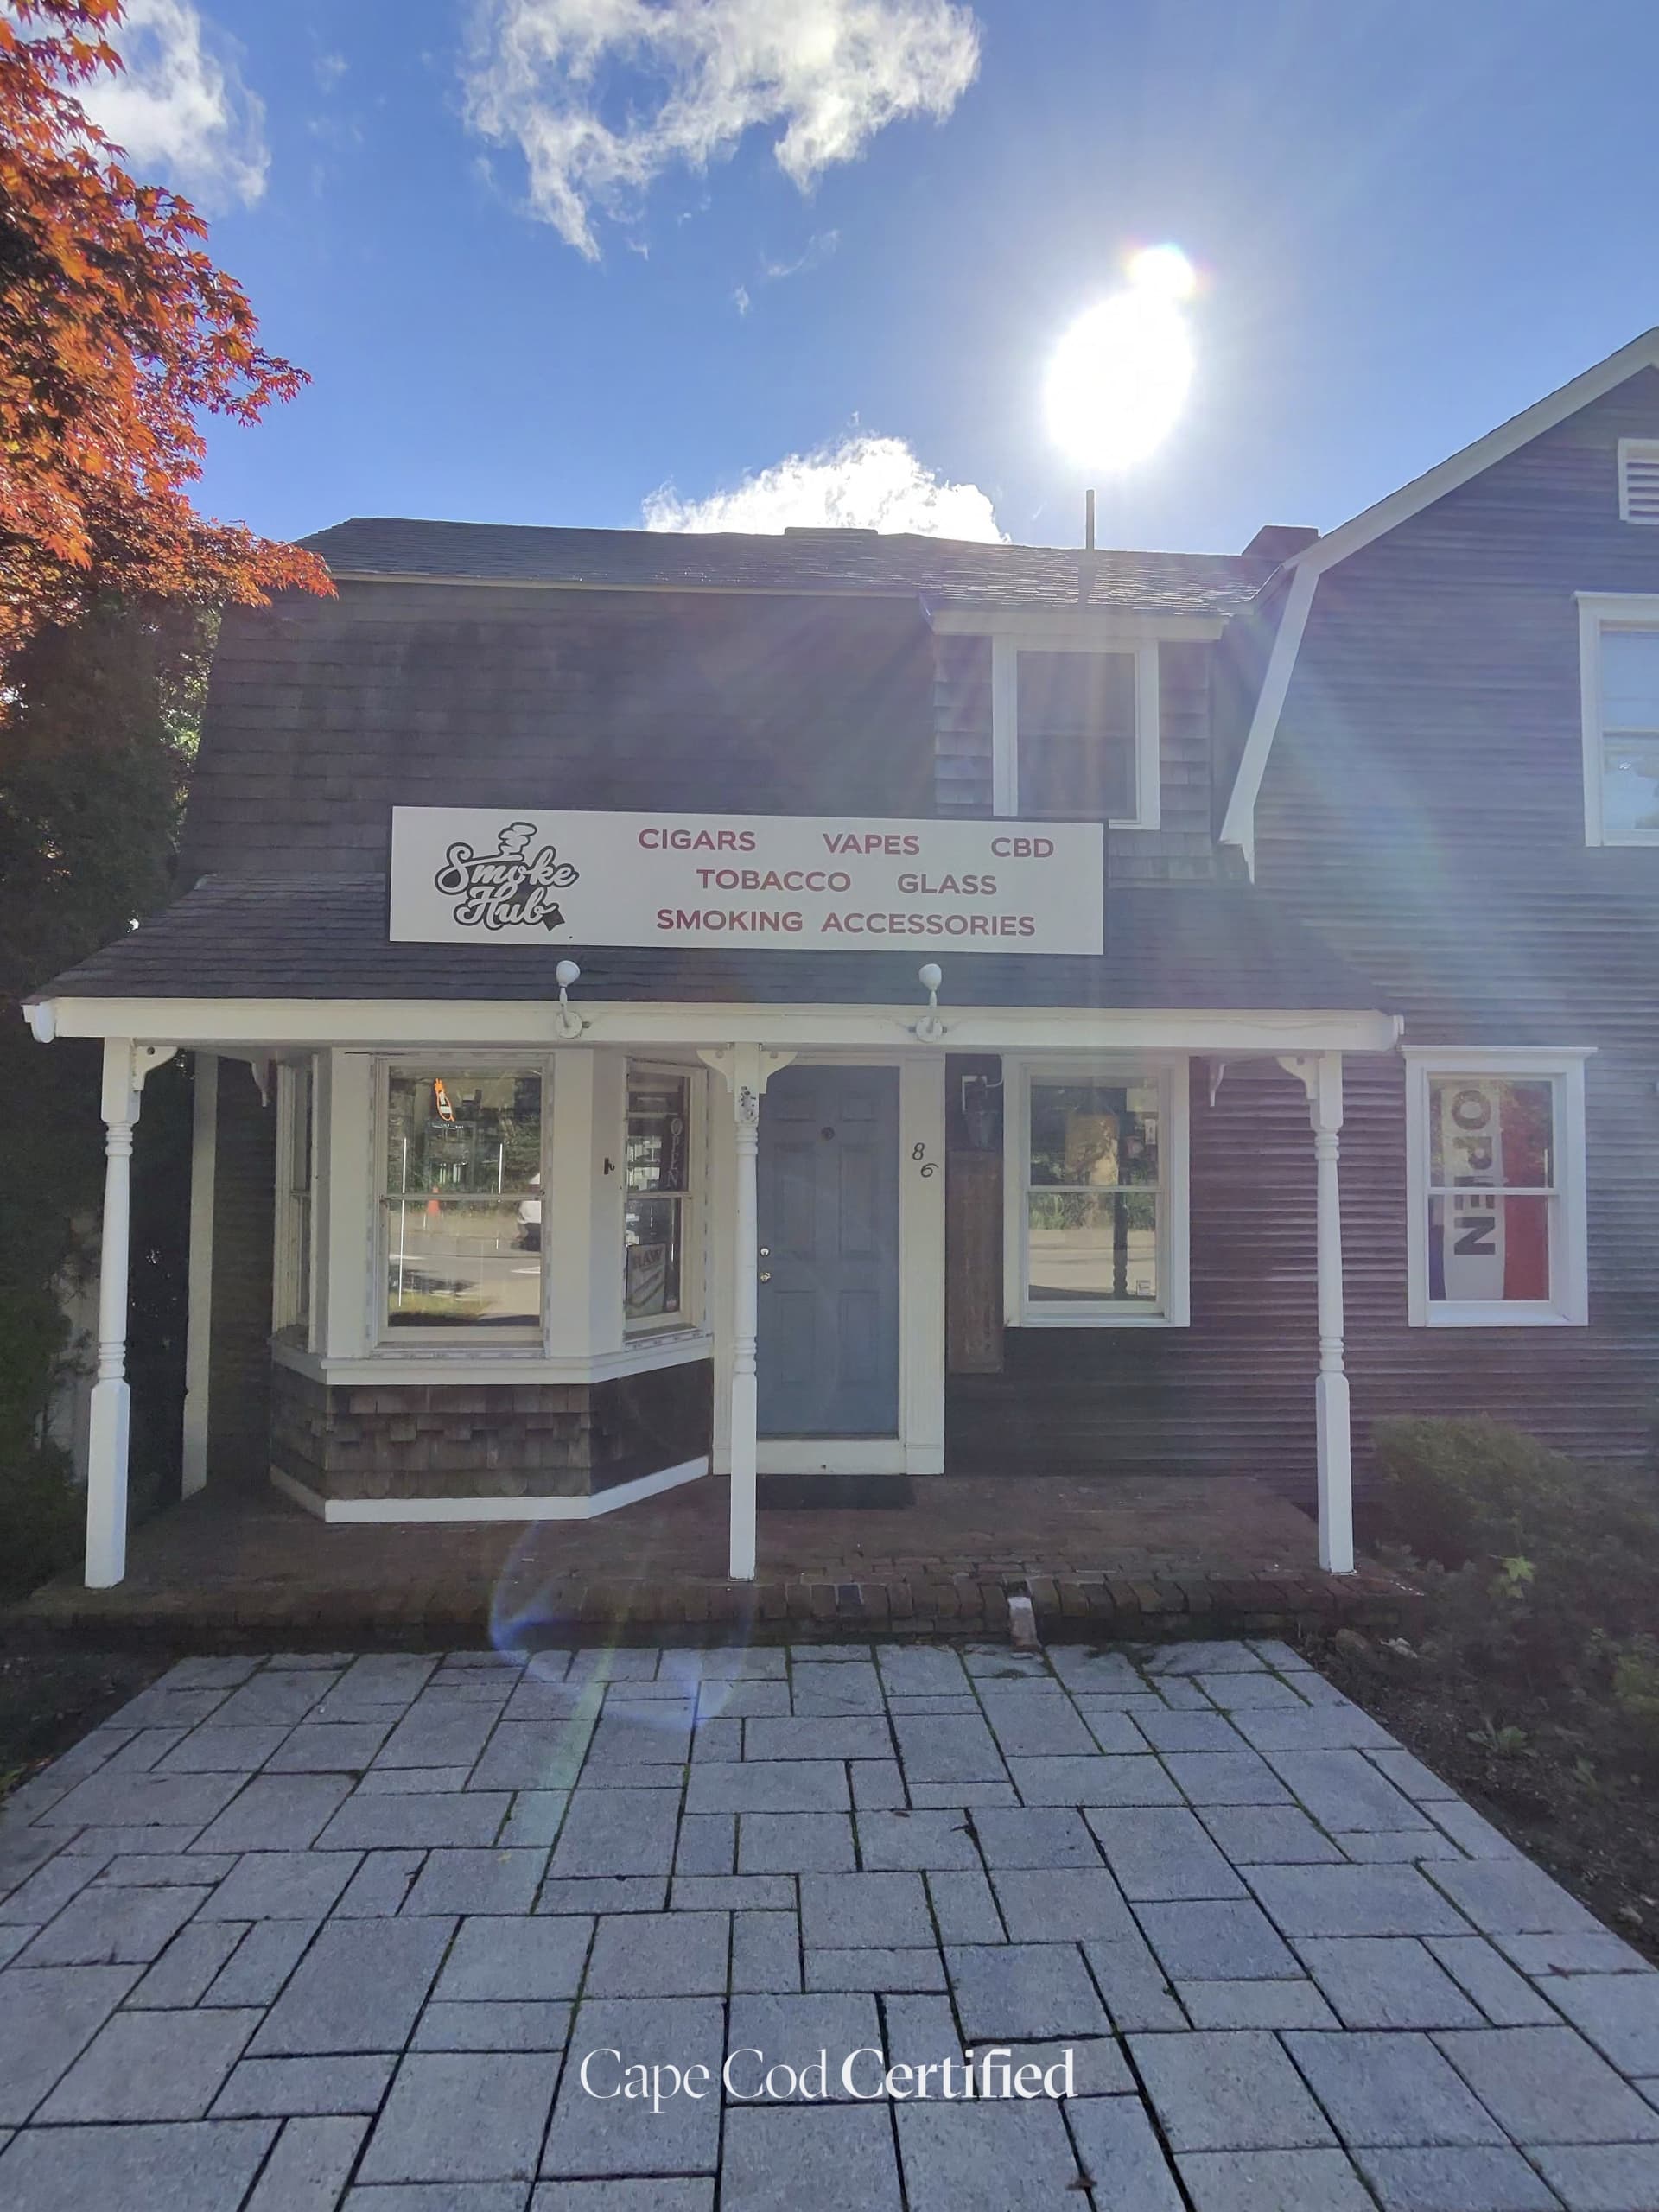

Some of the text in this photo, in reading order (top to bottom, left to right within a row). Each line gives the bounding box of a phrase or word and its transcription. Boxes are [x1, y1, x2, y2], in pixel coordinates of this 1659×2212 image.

[639, 829, 1054, 858] CIGARS VAPES CBD
[435, 842, 580, 895] Smoke
[696, 868, 997, 895] TOBACCO GLASS
[453, 885, 560, 931] Hub
[656, 909, 1036, 936] SMOKING ACCESSORIES
[1451, 1090, 1496, 1255] OPEN
